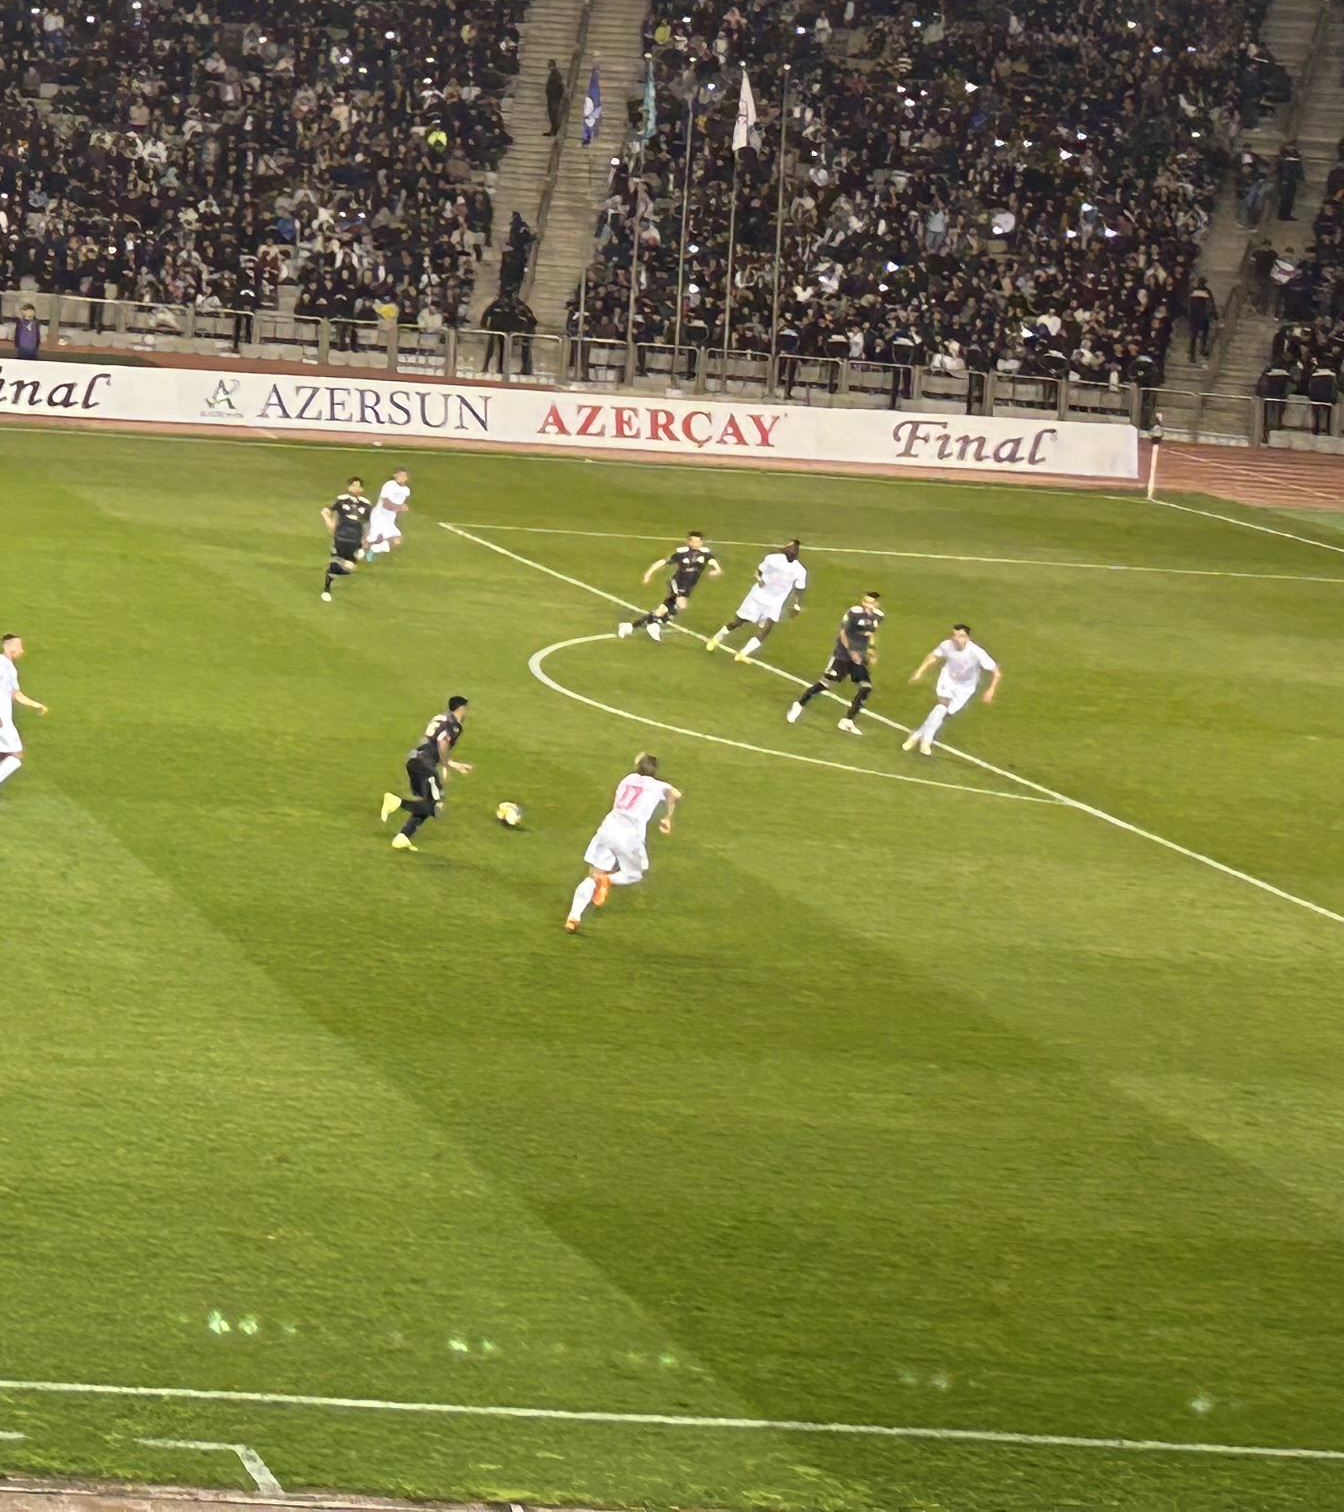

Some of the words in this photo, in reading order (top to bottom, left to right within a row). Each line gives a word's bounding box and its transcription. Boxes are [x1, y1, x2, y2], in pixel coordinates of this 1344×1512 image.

[255, 382, 493, 432] AZERSUN
[536, 404, 781, 449] AZERÇAY
[892, 420, 1058, 466] Final
